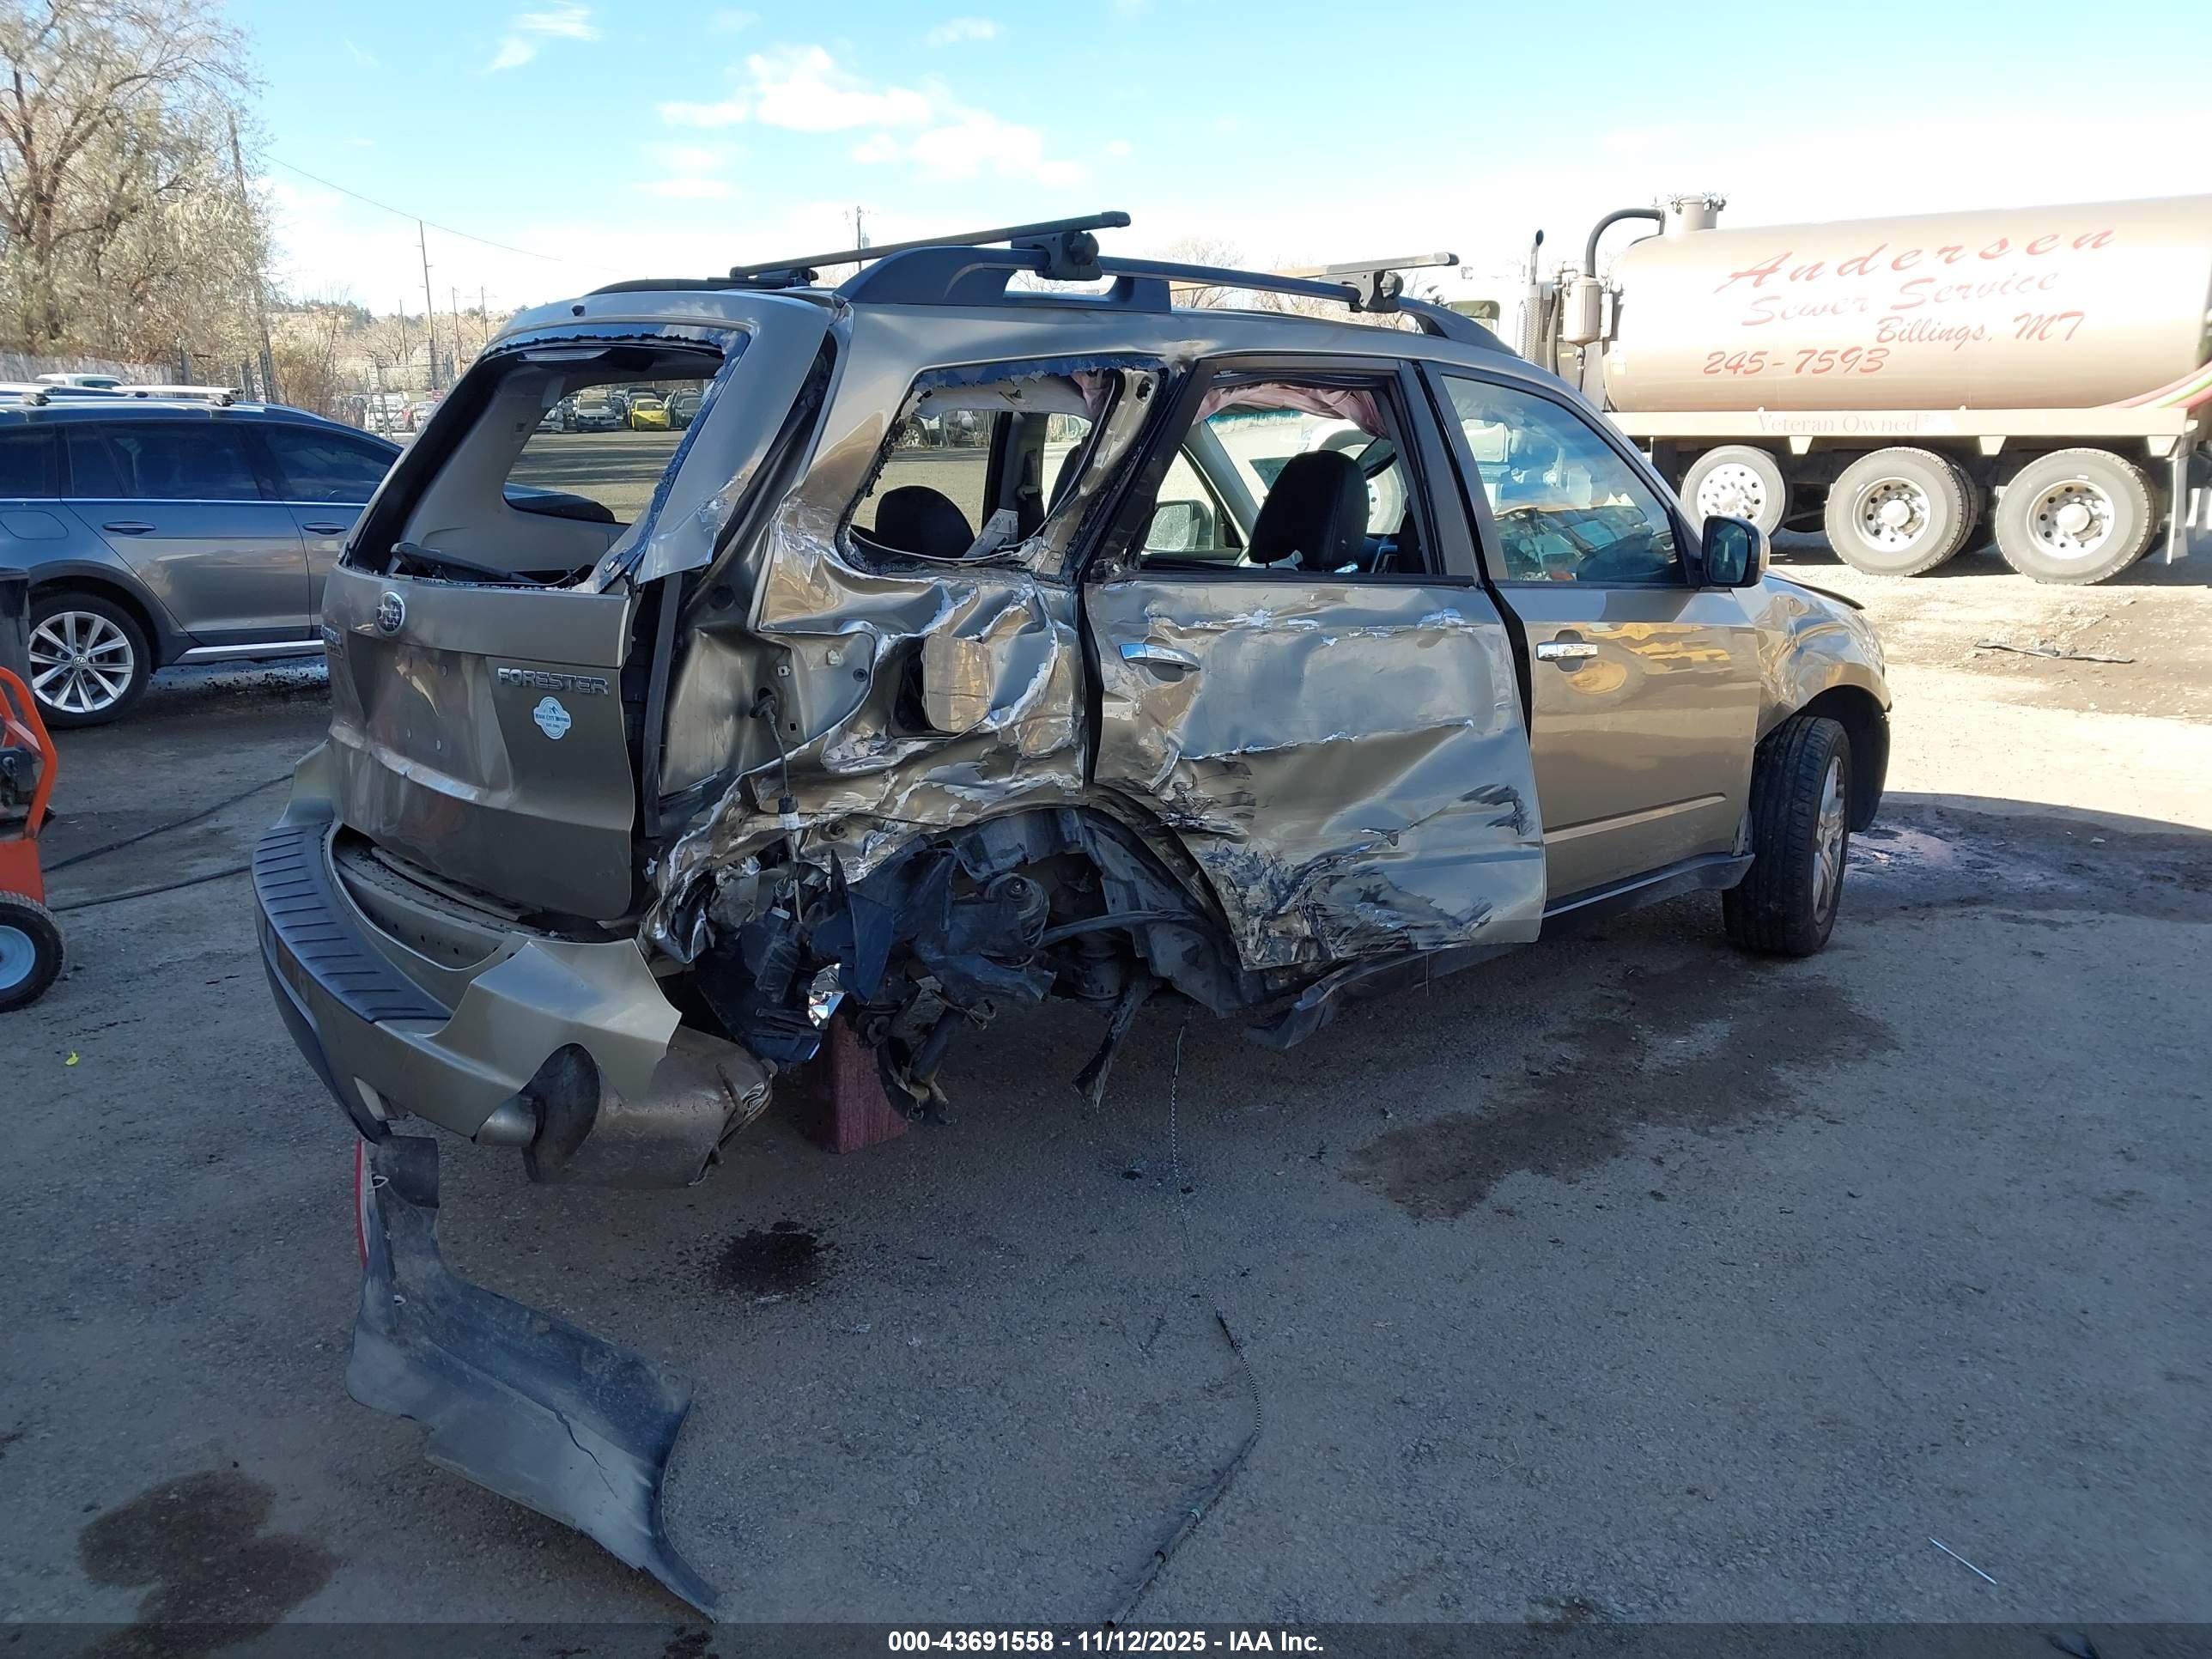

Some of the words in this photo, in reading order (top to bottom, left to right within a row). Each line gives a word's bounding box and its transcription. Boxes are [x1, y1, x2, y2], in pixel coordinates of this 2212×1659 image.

[1712, 227, 2114, 294] Andersen
[1741, 295, 1869, 326] Sewer
[1890, 269, 2060, 311] Service
[2013, 310, 2086, 341] MT
[1703, 346, 1888, 375] 245-7593
[1758, 414, 1835, 433] Veteran
[1842, 412, 1919, 433] Owned
[497, 667, 609, 695] FORESTER
